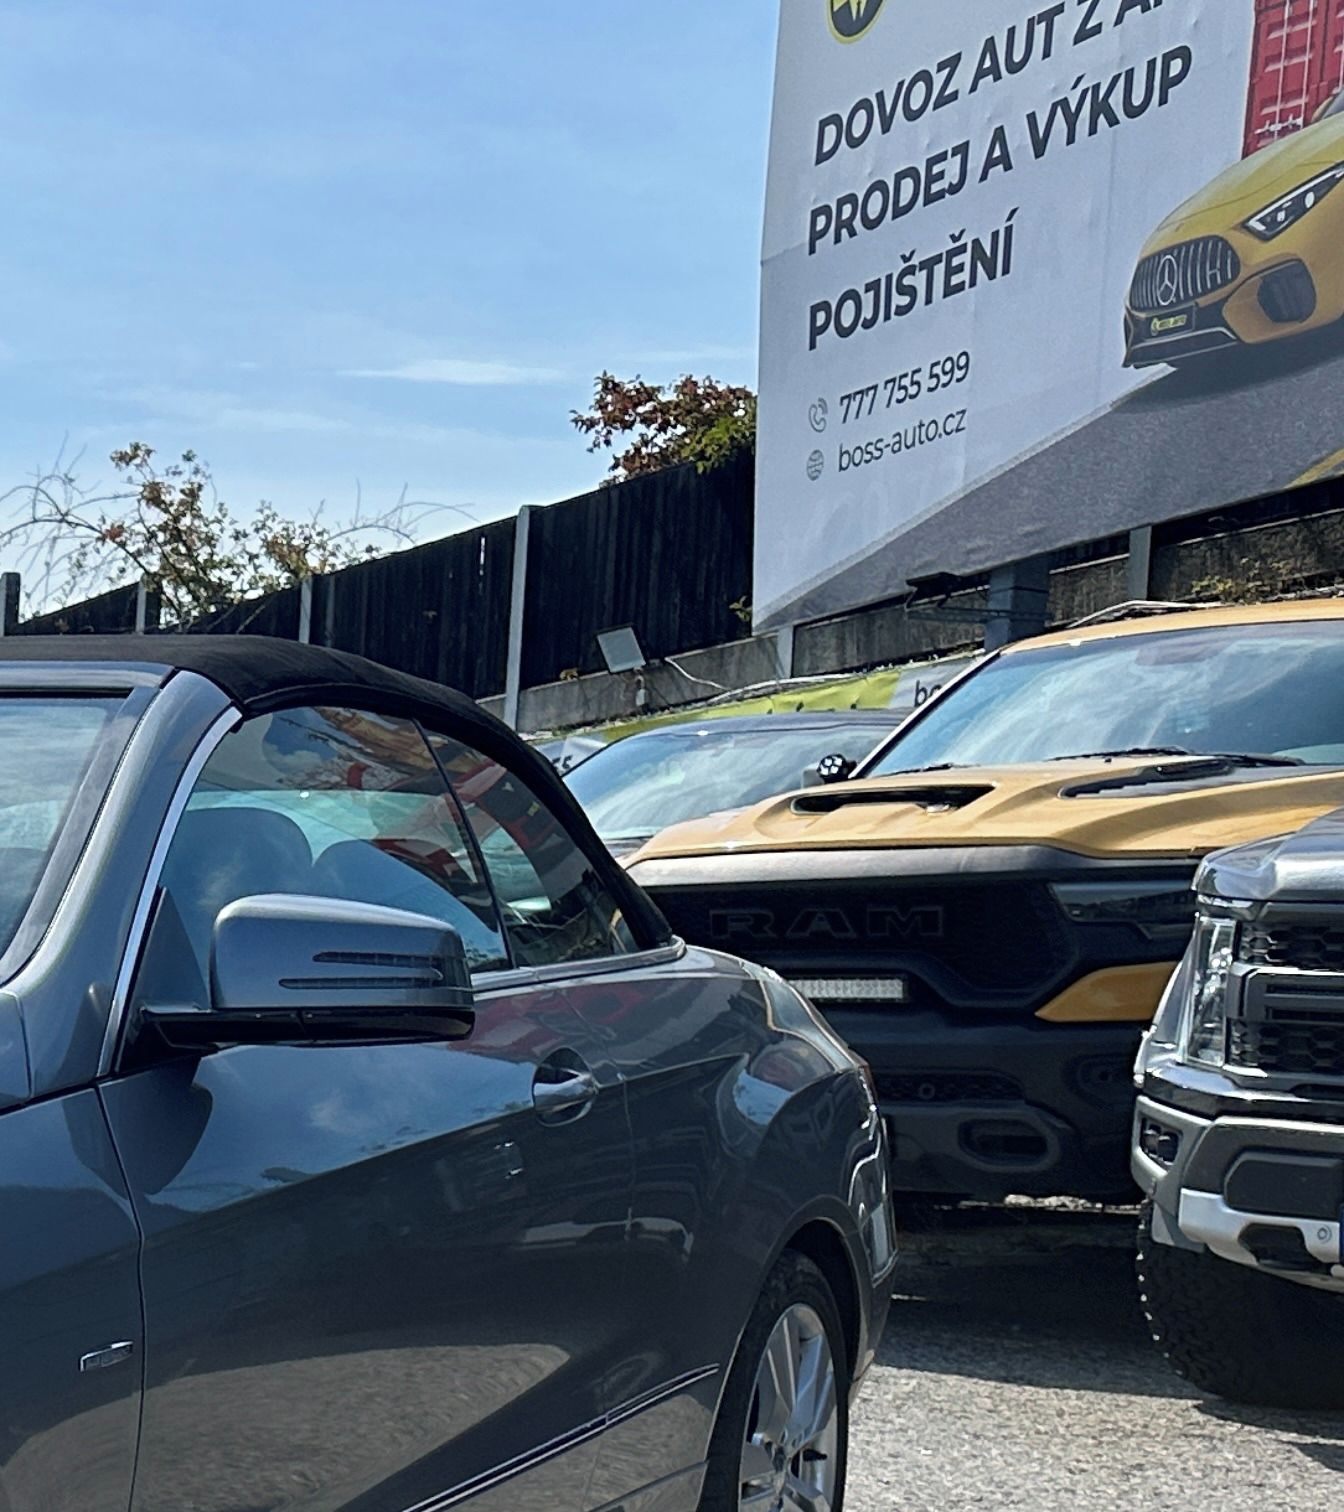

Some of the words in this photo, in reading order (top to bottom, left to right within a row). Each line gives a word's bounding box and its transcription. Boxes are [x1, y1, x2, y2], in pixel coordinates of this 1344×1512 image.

[815, 51, 962, 166] DOVOZ
[968, 3, 1064, 95] AUT
[1072, 0, 1103, 46] Z
[808, 140, 970, 256] PRODEJ
[979, 125, 1013, 184] A
[1026, 45, 1192, 160] VÝKUP
[808, 207, 1019, 351] POJIŠTĚNÍ
[838, 408, 968, 472] boss-auto.cz
[839, 384, 879, 425] 777
[884, 367, 922, 408] 755
[927, 350, 971, 392] 599
[709, 906, 944, 940] RAM
